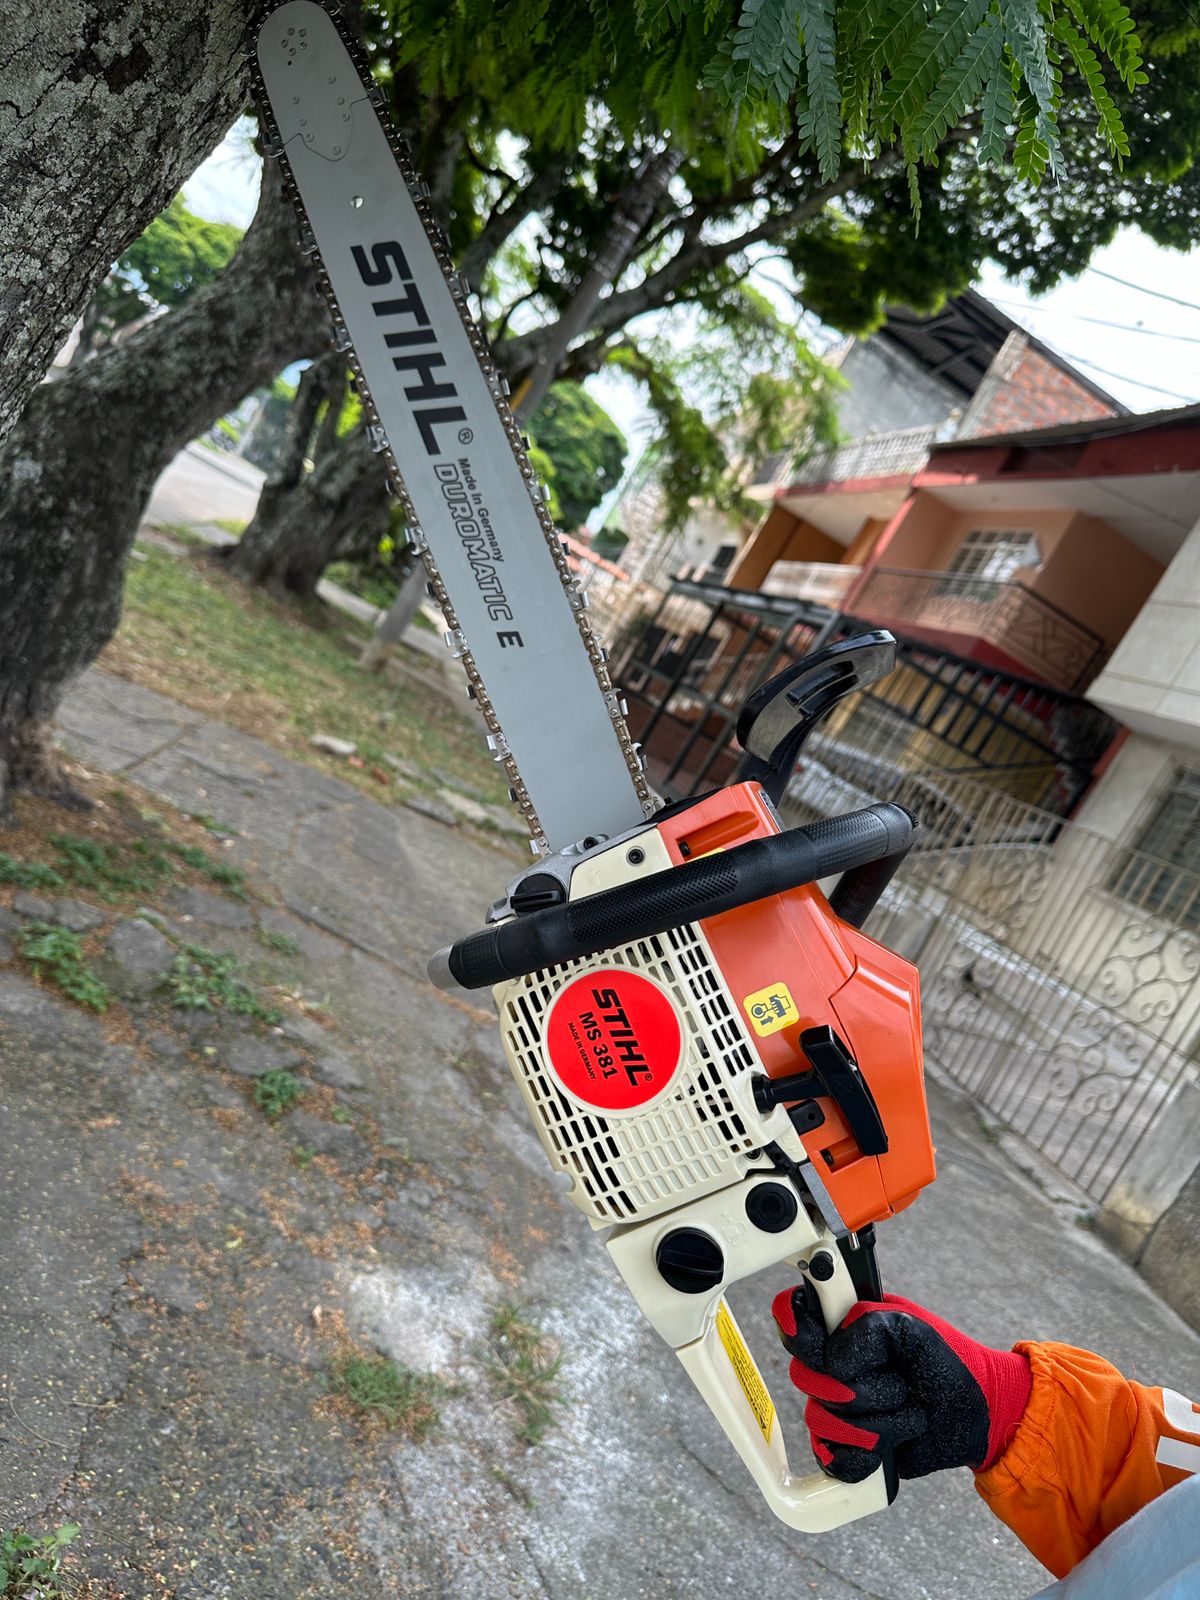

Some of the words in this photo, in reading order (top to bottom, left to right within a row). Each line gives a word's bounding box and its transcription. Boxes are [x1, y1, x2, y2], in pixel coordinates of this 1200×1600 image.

[458, 458, 476, 490] Made
[478, 508, 504, 562] Germany
[433, 464, 513, 621] DUROMATIC
[496, 631, 524, 648] E
[568, 1022, 580, 1041] MADE
[581, 1049, 597, 1080] GERMANY
[579, 1011, 602, 1041] MS
[593, 1044, 618, 1079] 381
